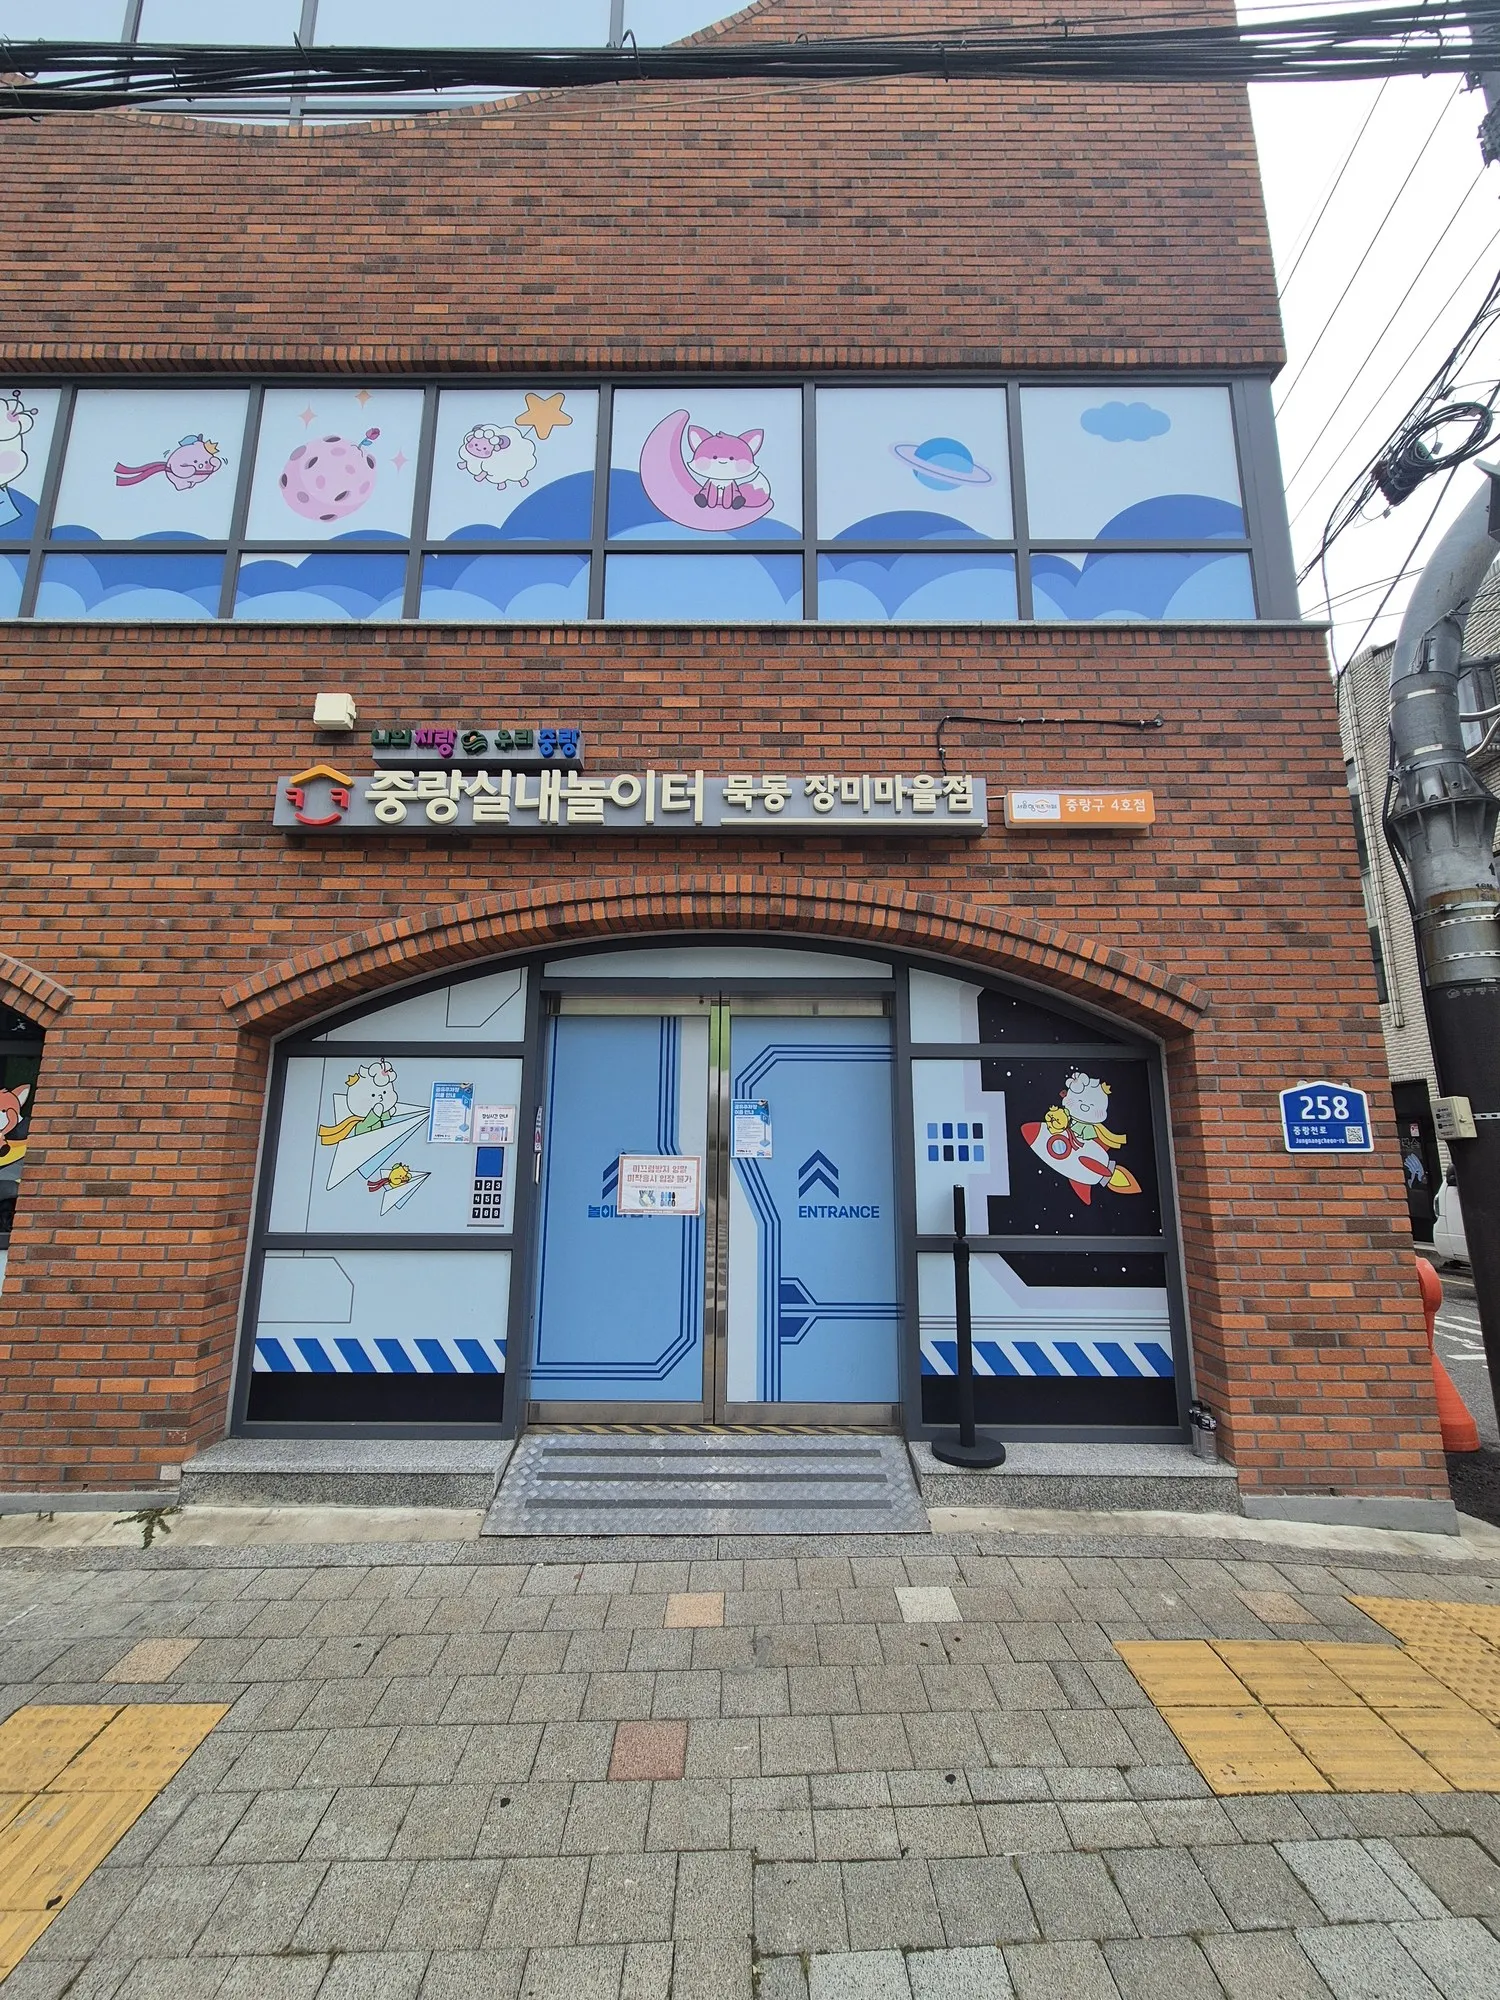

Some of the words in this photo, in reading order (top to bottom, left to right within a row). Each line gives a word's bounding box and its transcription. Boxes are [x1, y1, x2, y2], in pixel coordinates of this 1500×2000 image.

[372, 730, 412, 749] 나의
[414, 729, 458, 758] 자랑
[494, 729, 533, 752] 우리
[538, 729, 580, 758] 중랑
[364, 769, 704, 825] 중랑실내놀이터
[722, 774, 793, 812] 묵동
[804, 774, 974, 813] 장미마을점
[1065, 798, 1105, 812] 중랑구
[1111, 798, 1146, 812] 4호점
[1300, 1096, 1349, 1120] 258
[1293, 1126, 1328, 1136] 중랑천로
[632, 1165, 670, 1173] 미끄럼방지
[659, 1174, 675, 1183] 입장
[677, 1175, 692, 1183] 불가
[799, 1205, 880, 1219] ENTRANCE
